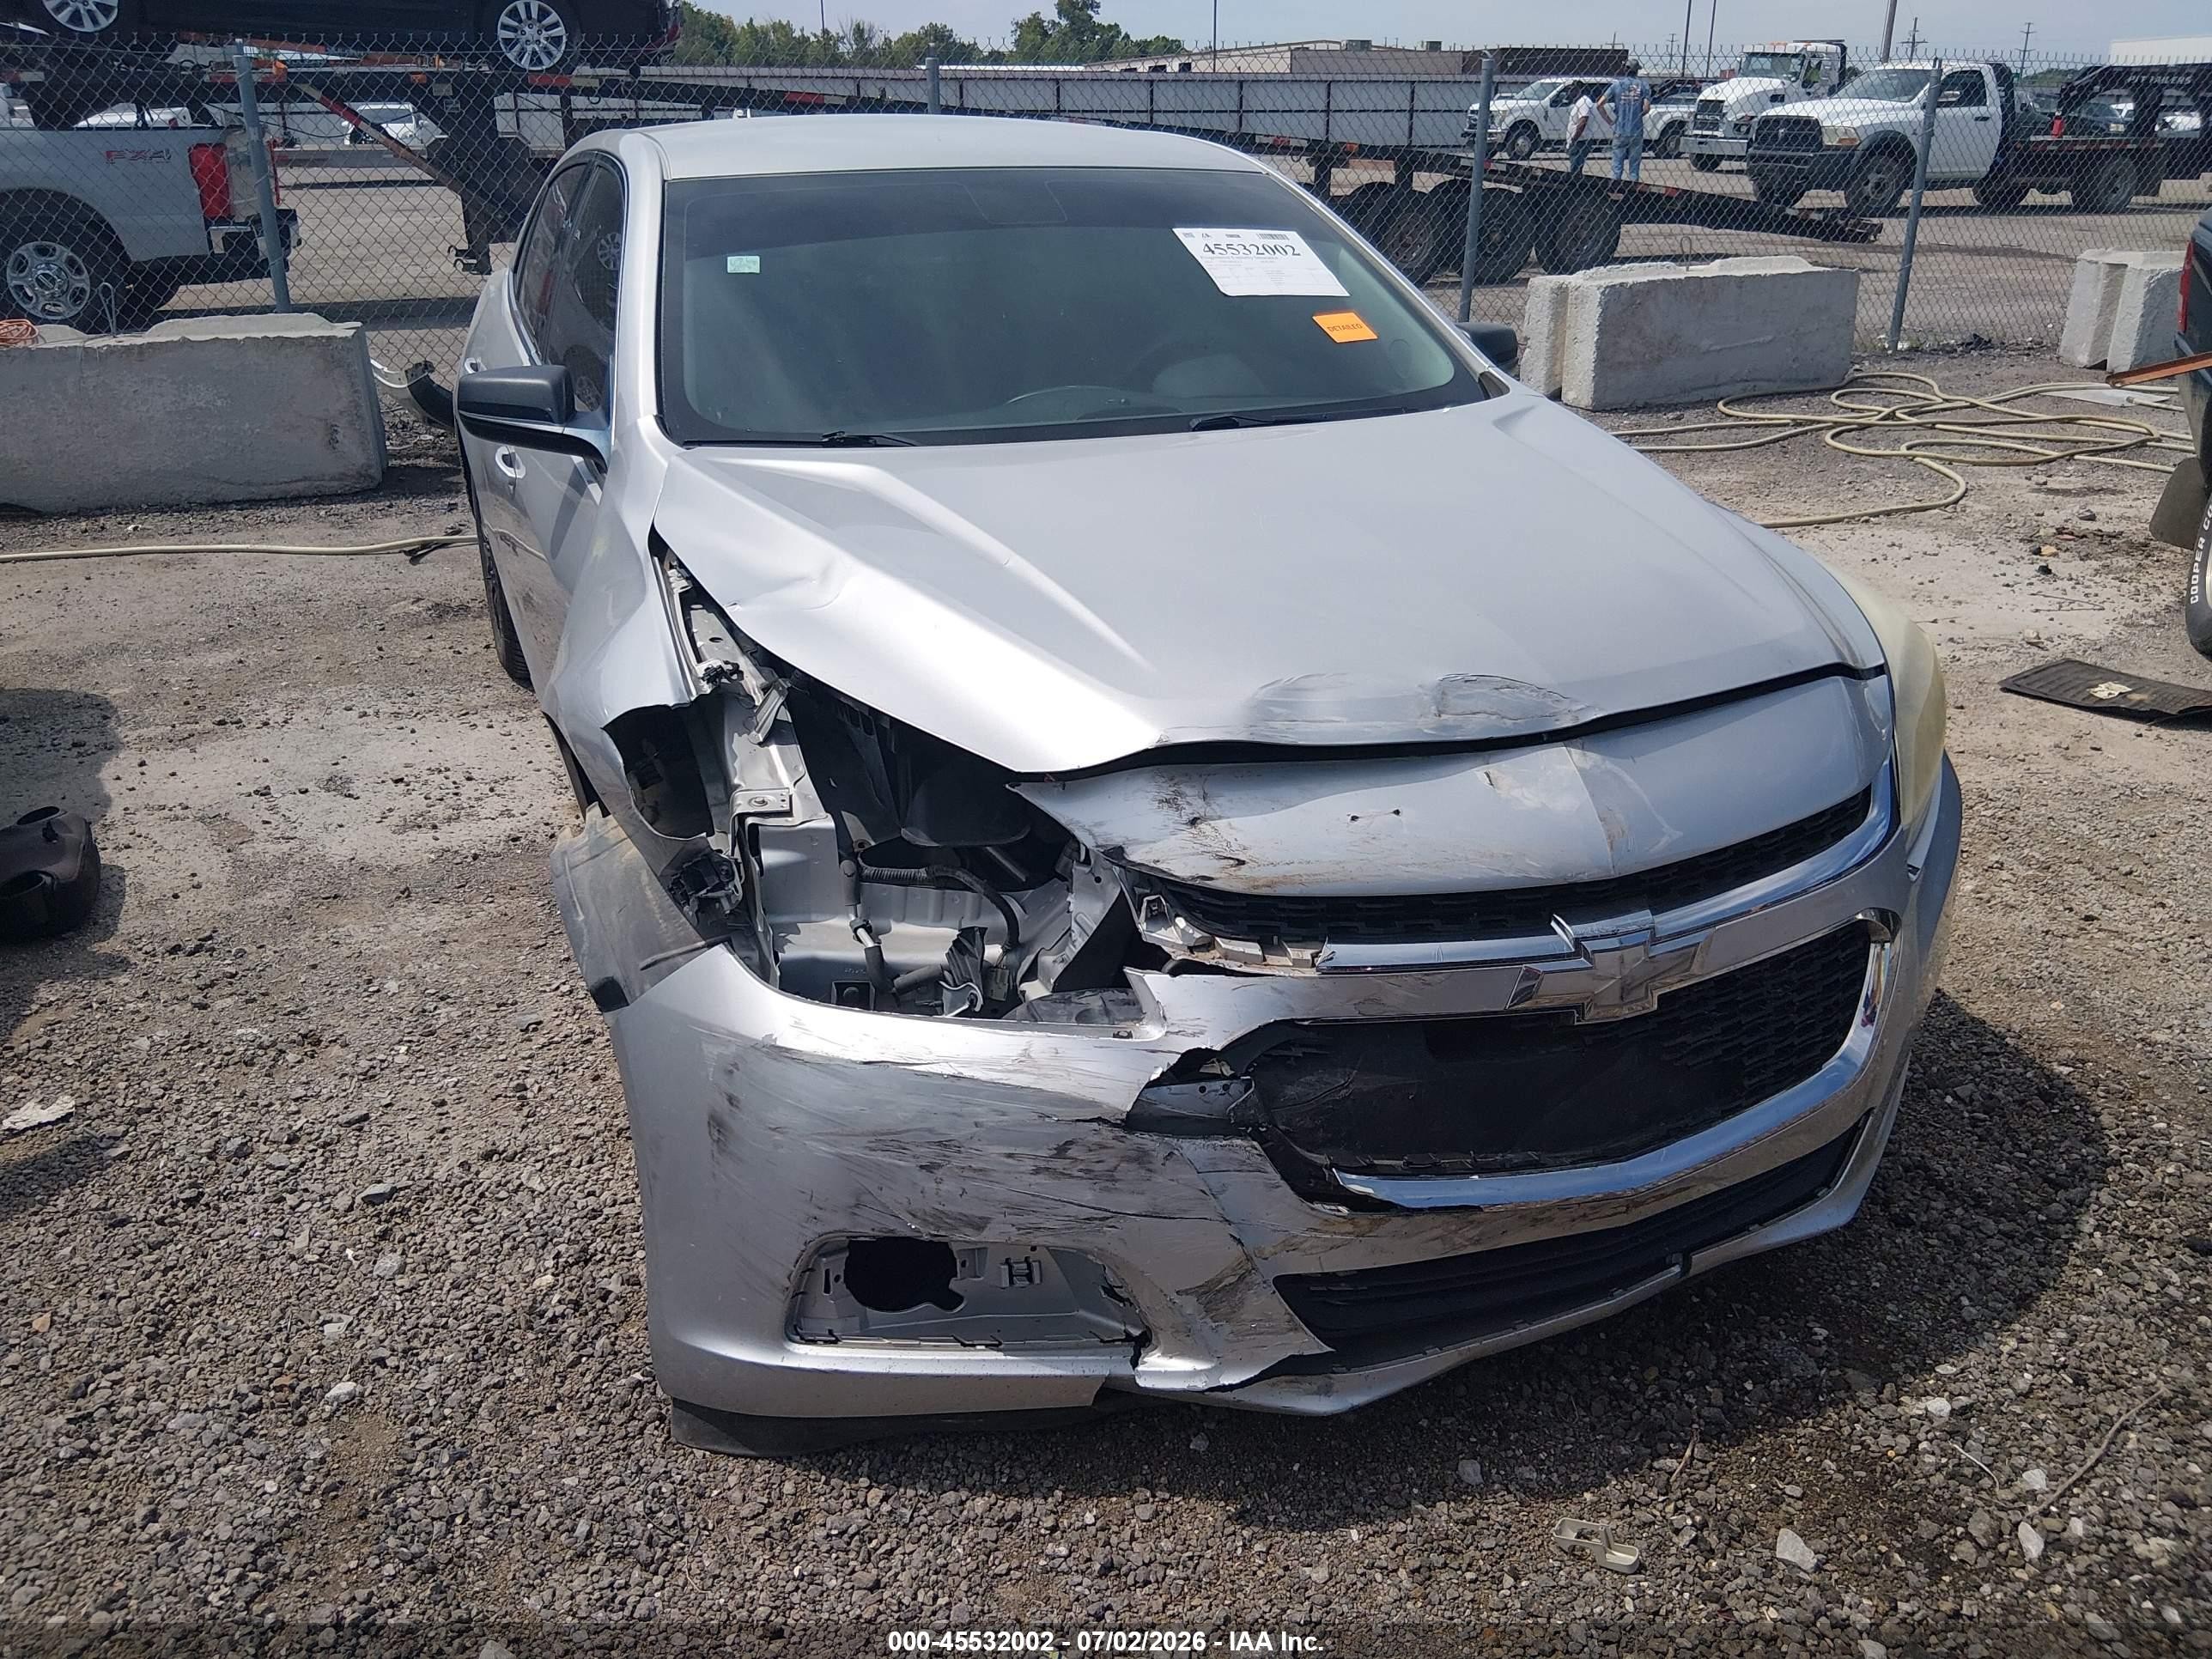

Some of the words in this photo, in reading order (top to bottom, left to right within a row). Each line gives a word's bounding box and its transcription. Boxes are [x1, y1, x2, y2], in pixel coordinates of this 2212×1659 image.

[1203, 243, 1301, 257] 45532002
[1327, 323, 1364, 332] DETAILED
[2190, 536, 2206, 605] COOPER
